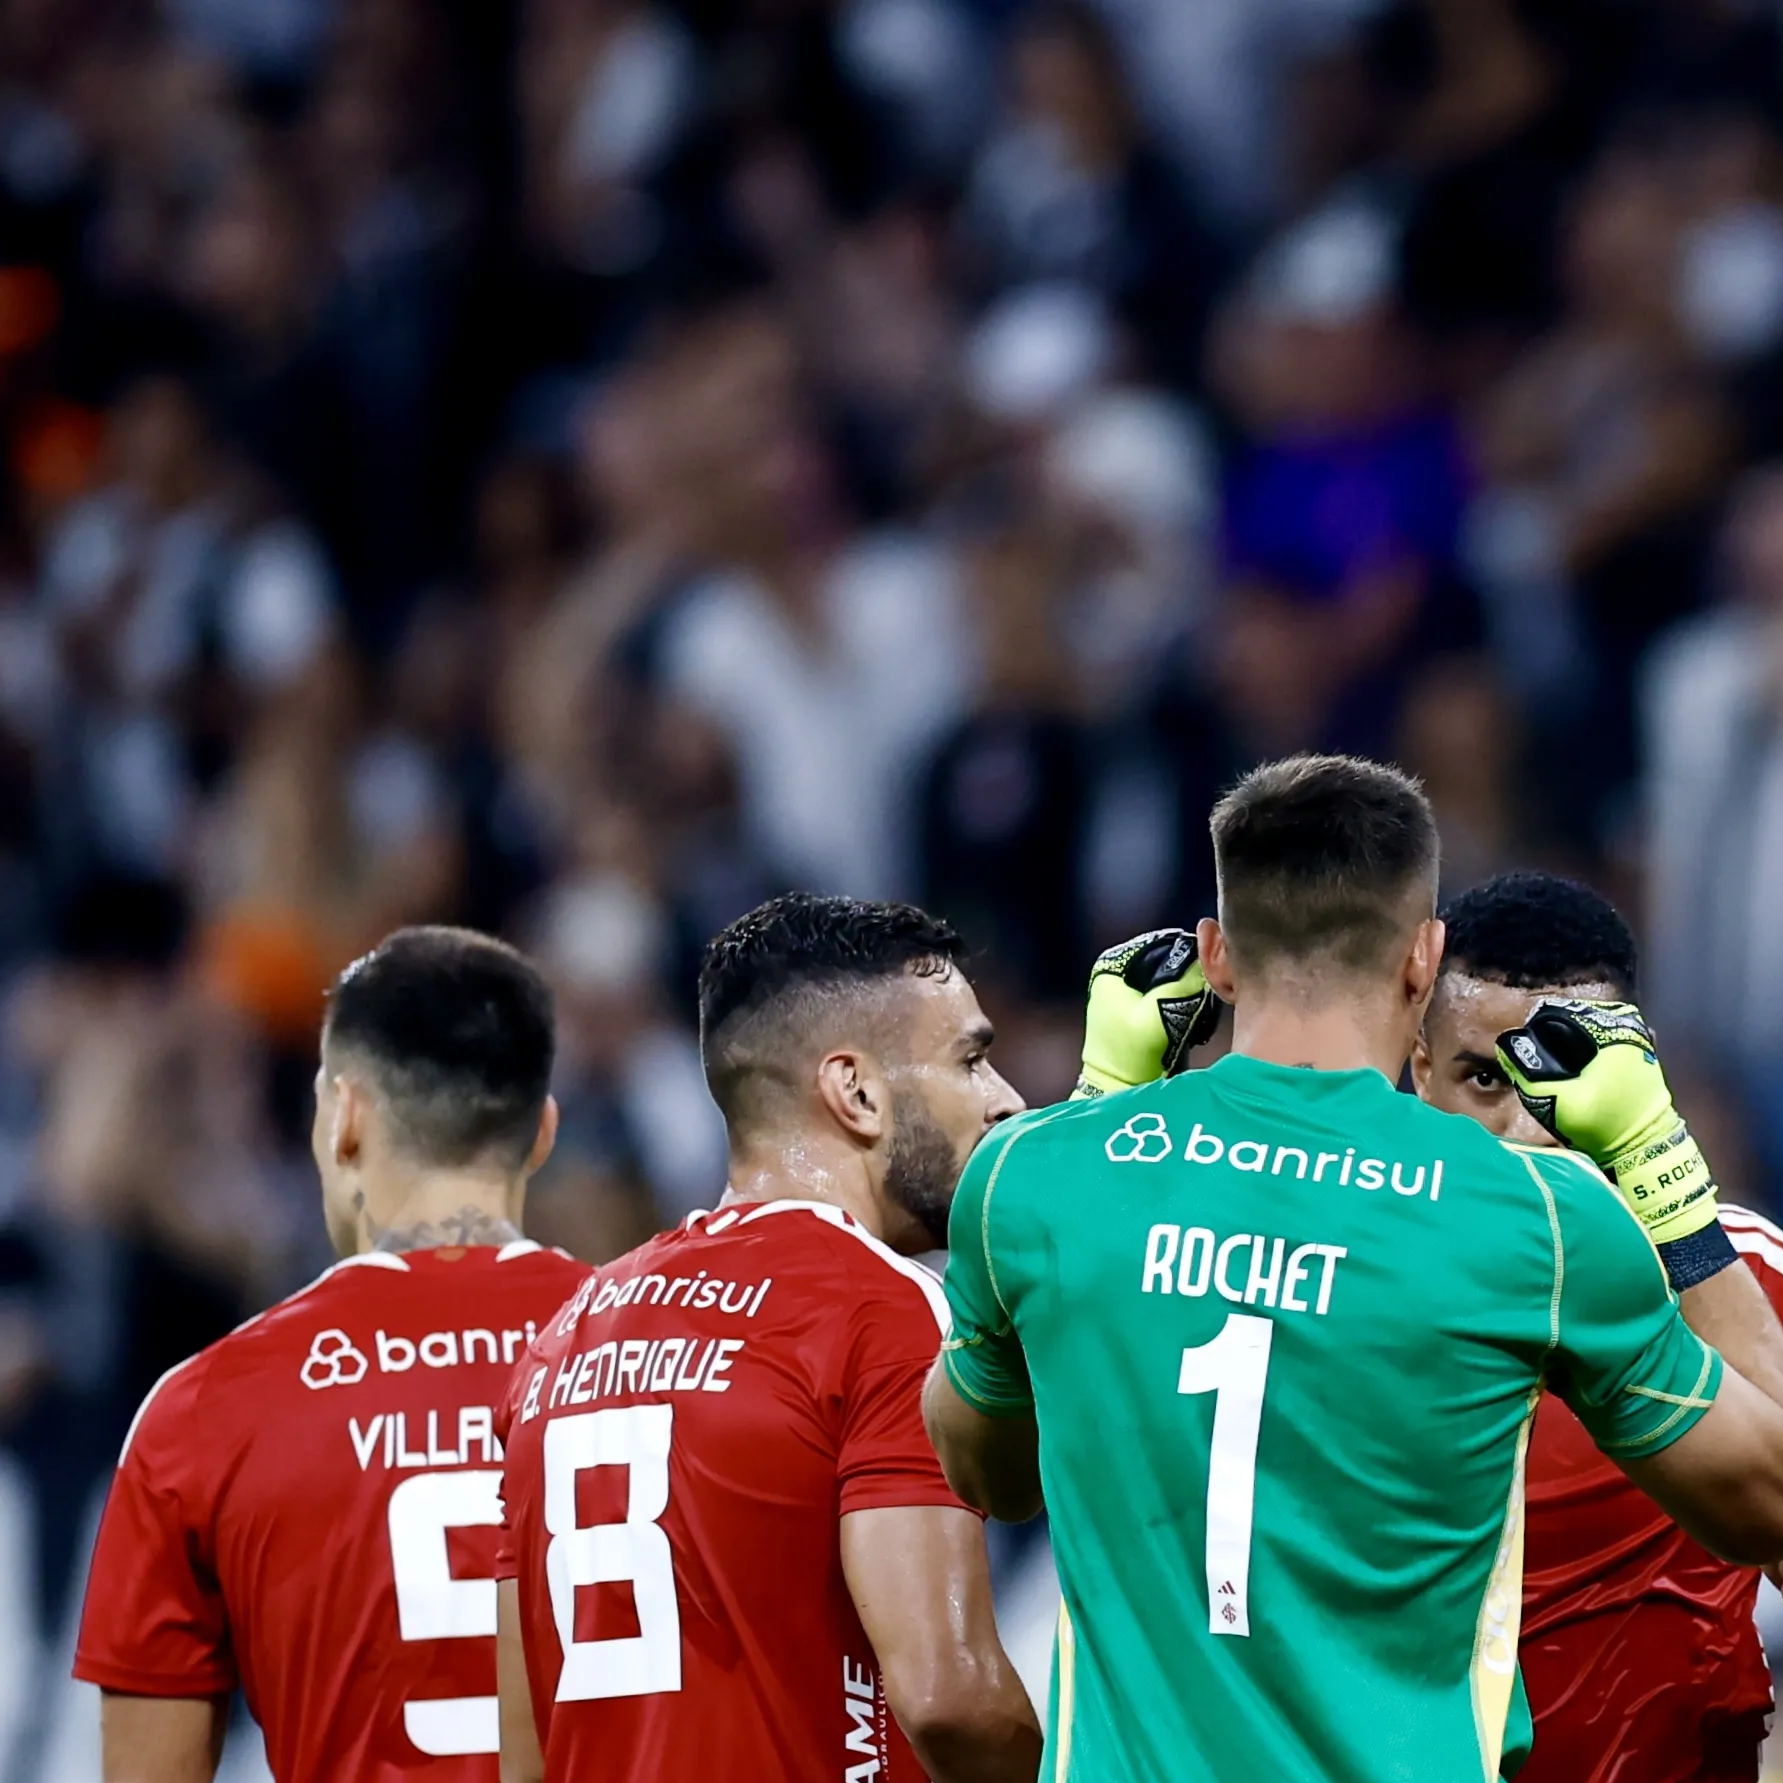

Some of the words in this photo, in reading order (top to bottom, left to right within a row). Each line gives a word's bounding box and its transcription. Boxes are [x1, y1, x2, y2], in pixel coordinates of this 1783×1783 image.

[1183, 1123, 1443, 1201] banrisul
[1633, 1184, 1656, 1200] S.
[589, 1270, 772, 1318] banrisul
[1141, 1223, 1348, 1315] ROCHET
[376, 1321, 536, 1372] banri
[549, 1338, 745, 1410] HENRIQUE
[348, 1406, 504, 1471] VILLA
[1177, 1313, 1274, 1637] 1
[544, 1403, 682, 1703] 8
